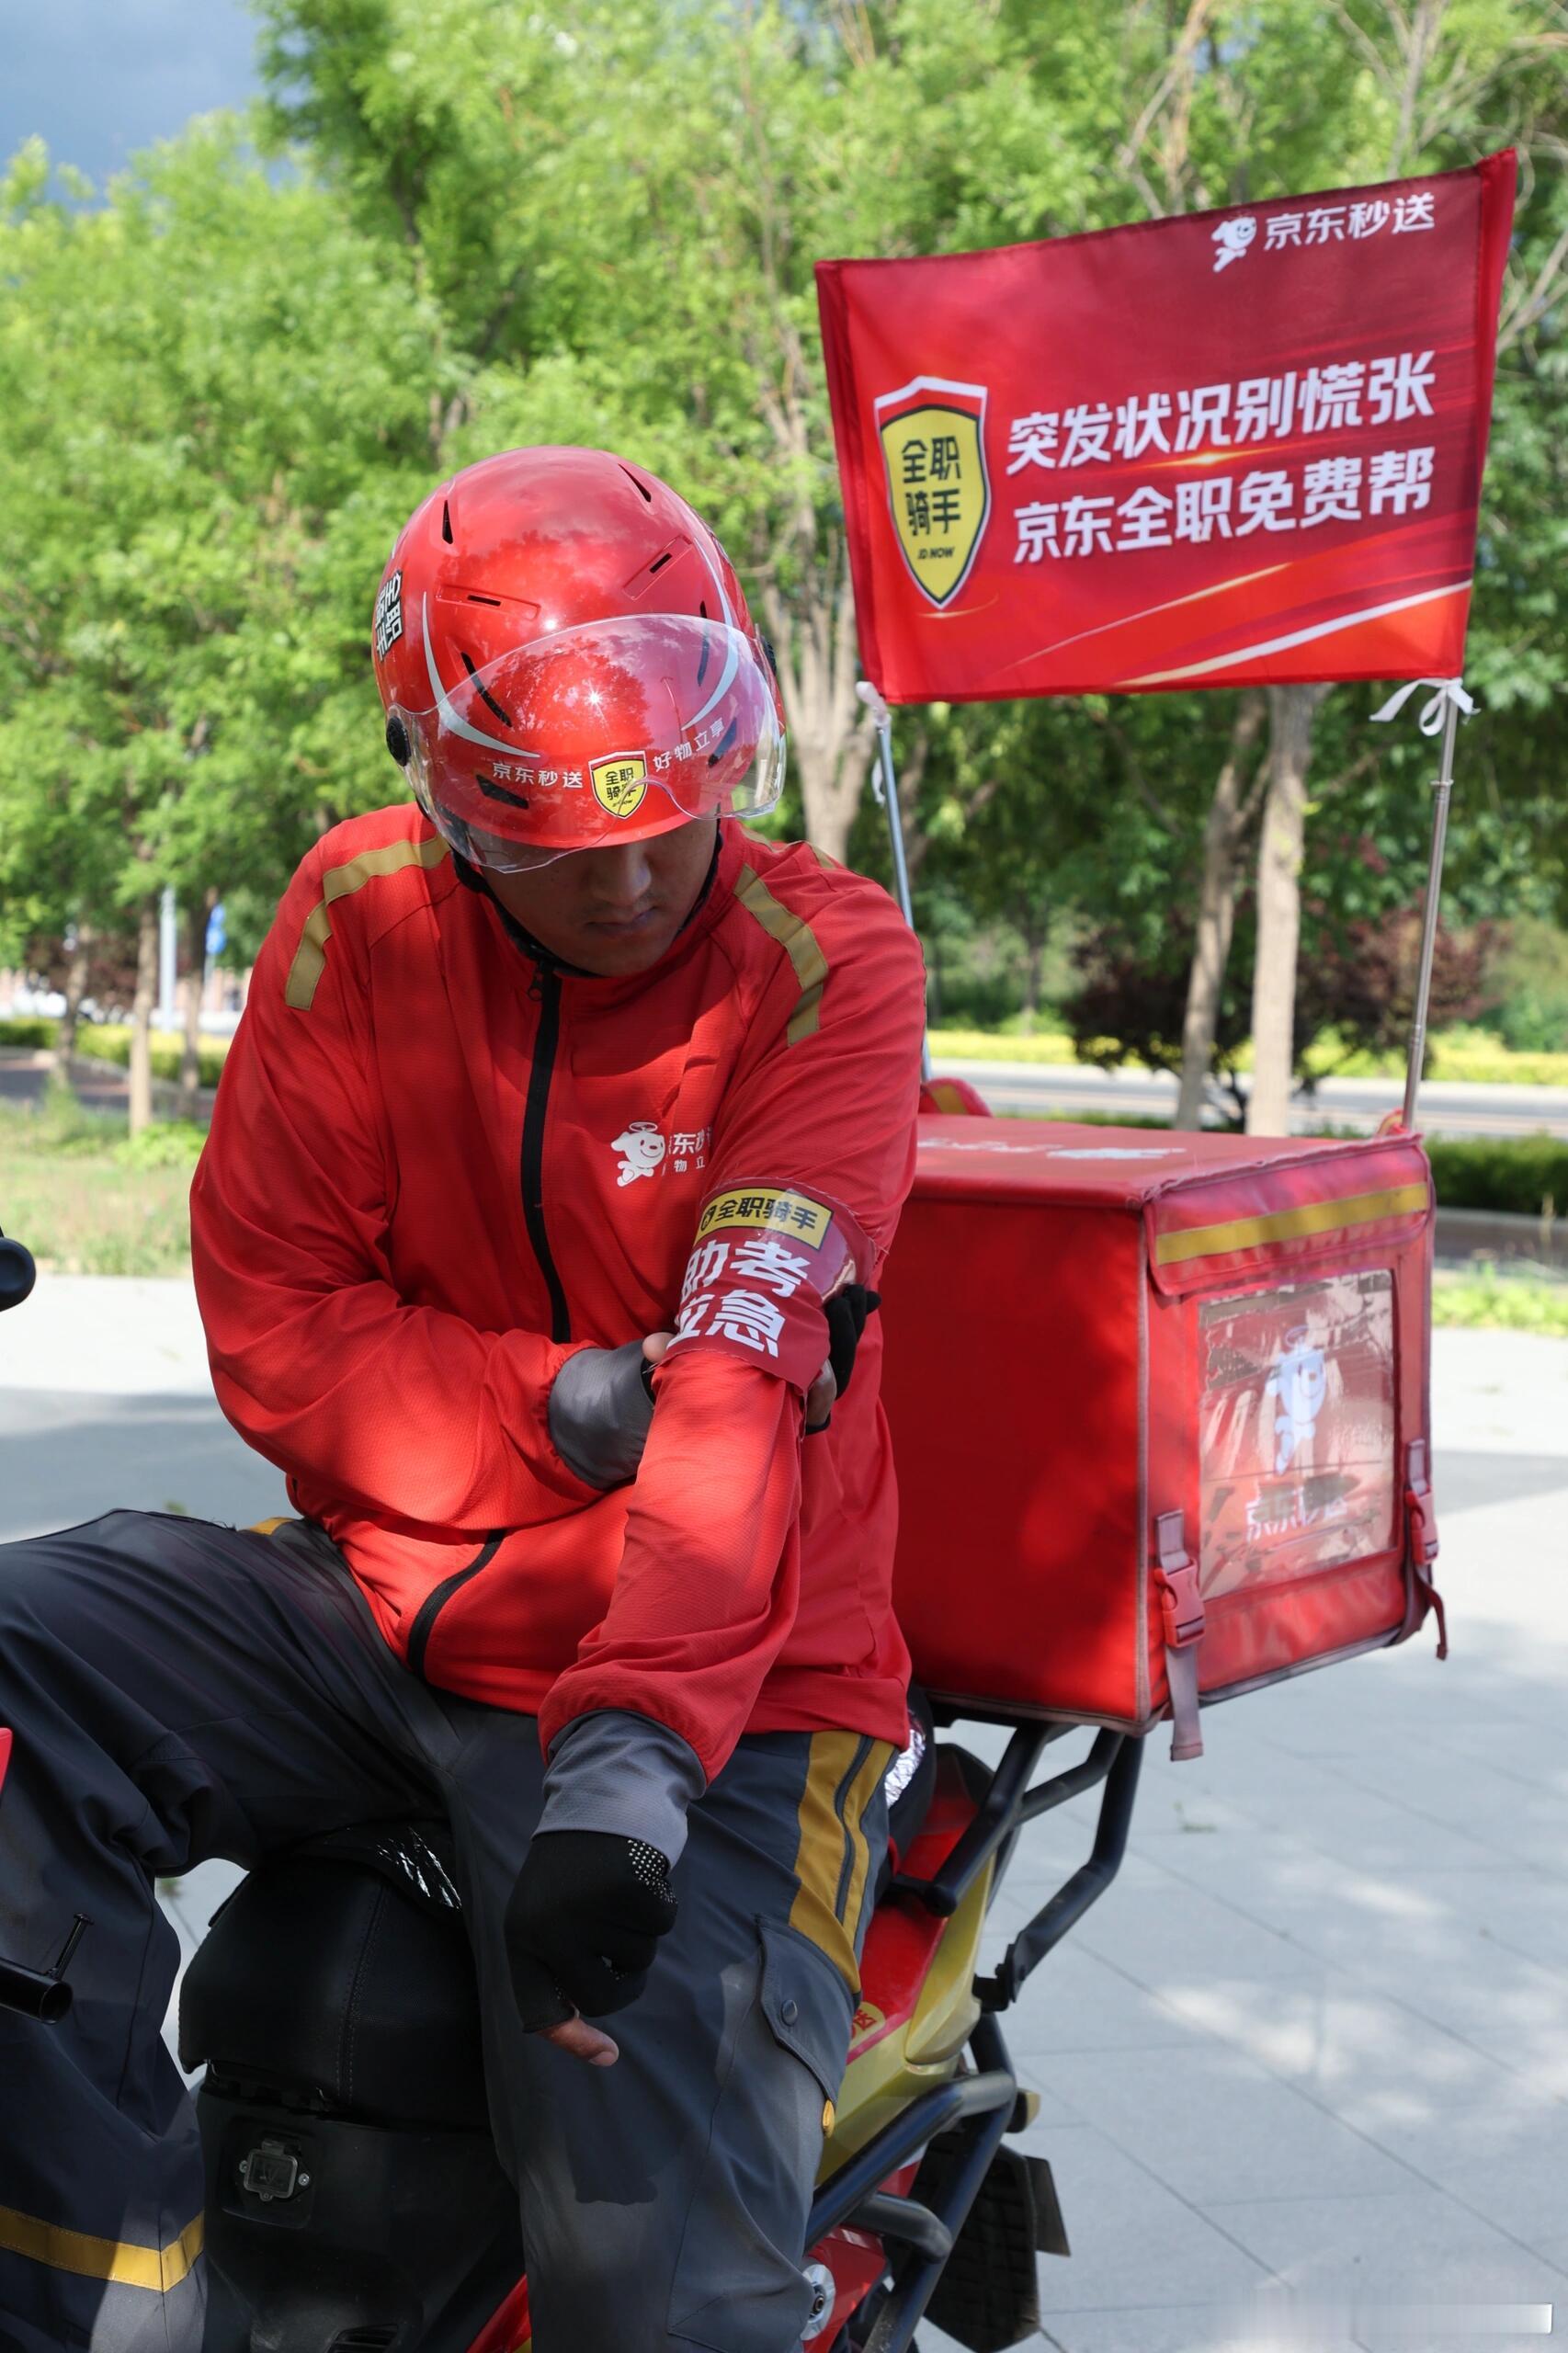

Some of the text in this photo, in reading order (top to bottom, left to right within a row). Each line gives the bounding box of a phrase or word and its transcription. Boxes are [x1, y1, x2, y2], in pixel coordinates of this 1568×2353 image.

[1265, 192, 1435, 251] 京东秒送
[1006, 350, 1435, 476] 突发状况别慌张
[902, 436, 961, 483] 全职
[905, 488, 961, 536] 骑手
[1014, 446, 1435, 563] 京东全职免费帮
[653, 717, 725, 773] 好物立享
[493, 762, 584, 790] 京东秒送
[606, 767, 634, 785] 全职
[714, 1197, 818, 1229] 全职骑手
